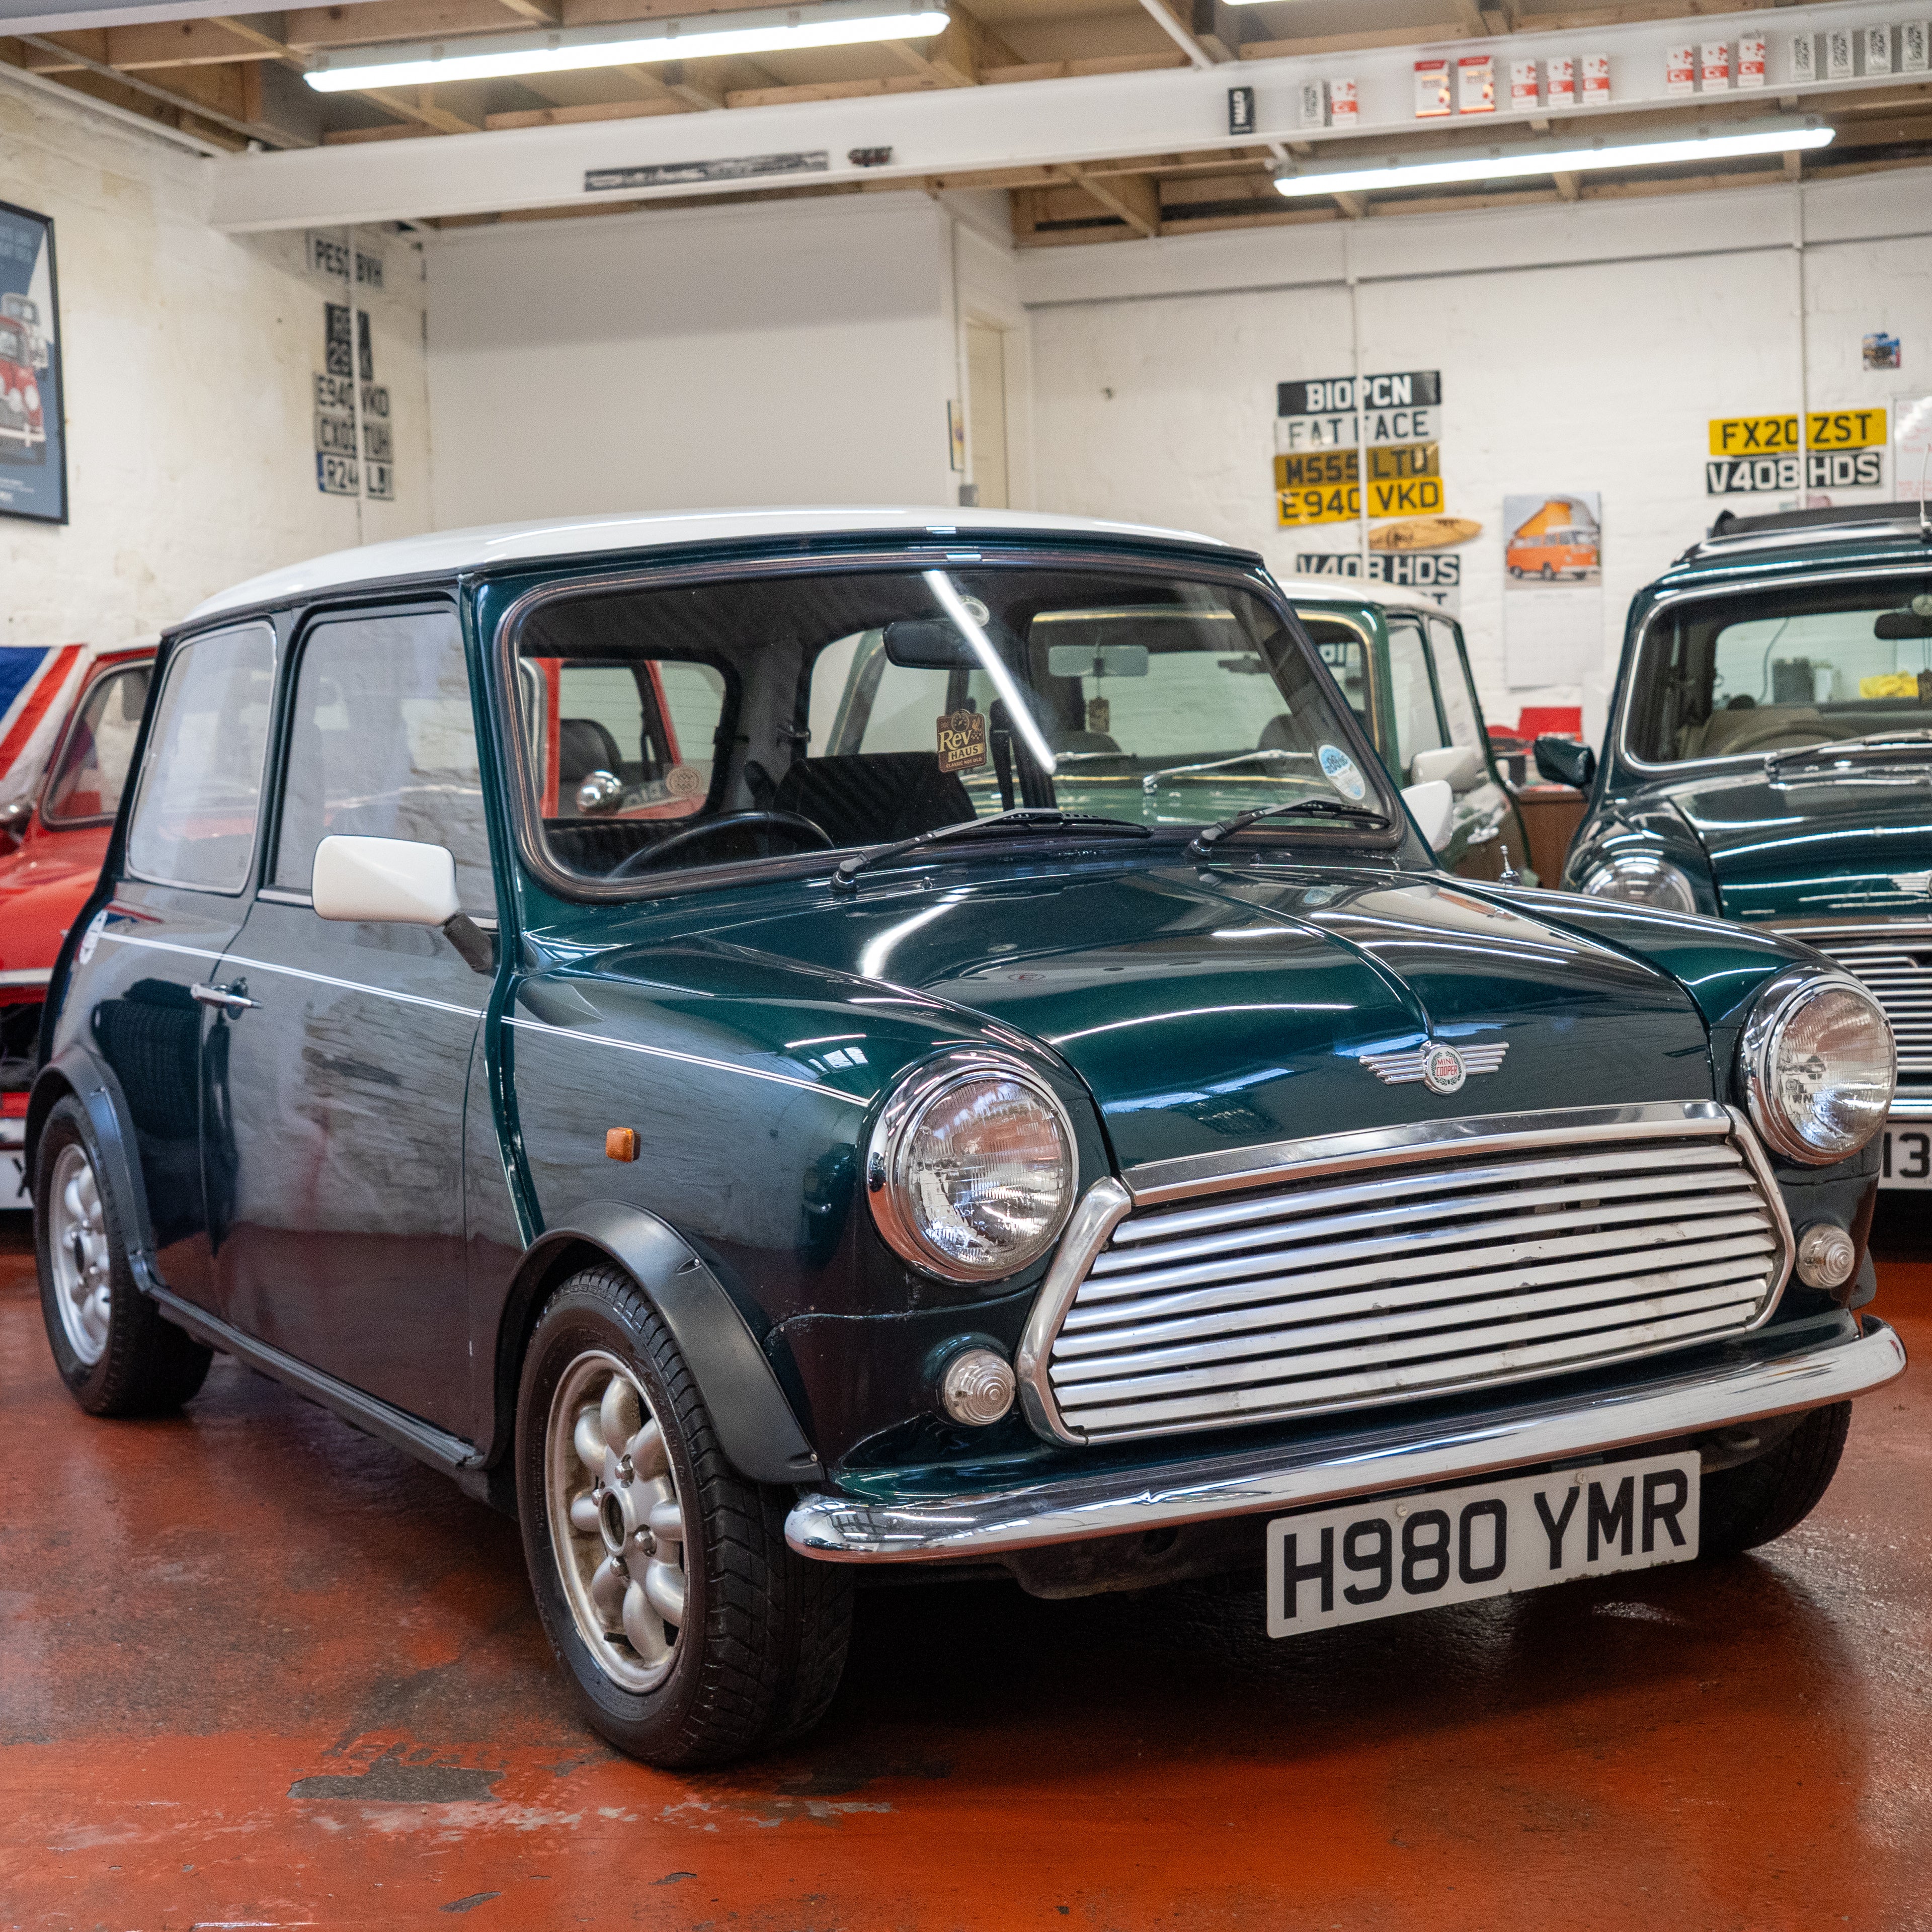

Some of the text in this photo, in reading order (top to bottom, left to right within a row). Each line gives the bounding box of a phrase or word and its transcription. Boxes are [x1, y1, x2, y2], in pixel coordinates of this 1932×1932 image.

[1722, 414, 1872, 450] FX20 ZST
[1709, 454, 1880, 492] V408 HDS
[1376, 481, 1439, 511] VKD
[1392, 555, 1459, 585] HDS
[951, 745, 978, 760] HAUS
[1436, 1065, 1458, 1077] COOPER
[1283, 1469, 1688, 1620] H980 YMR
